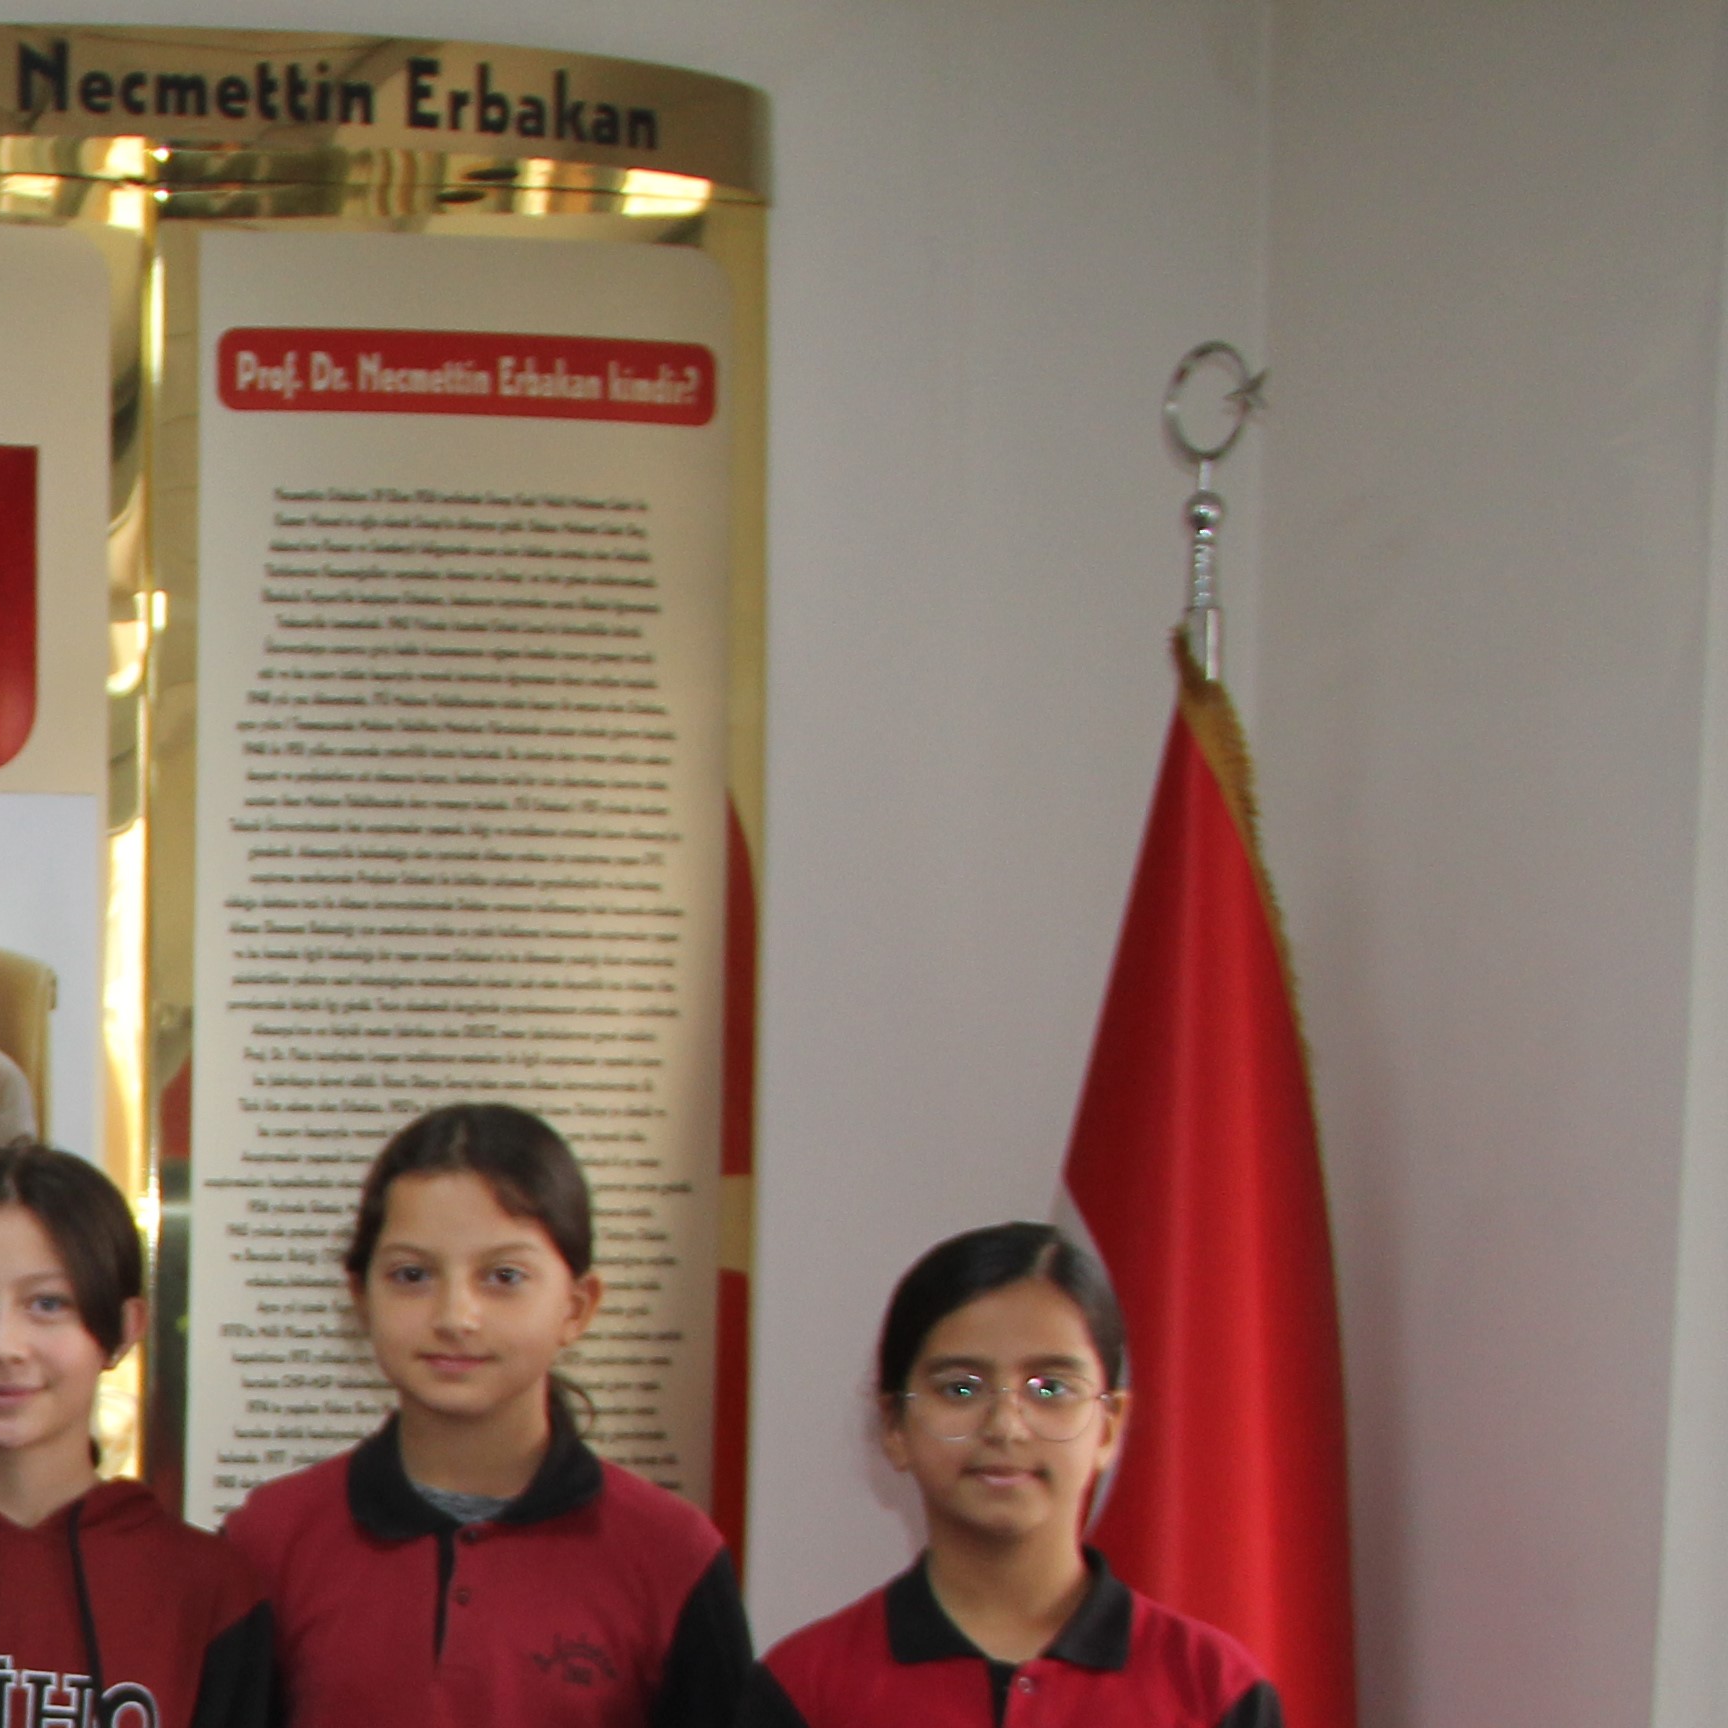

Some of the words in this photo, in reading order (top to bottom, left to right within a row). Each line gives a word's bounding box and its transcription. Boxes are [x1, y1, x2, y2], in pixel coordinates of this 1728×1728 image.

[17, 38, 374, 126] Necmettin
[406, 56, 661, 152] Erbakan
[235, 349, 302, 402] Prof.
[309, 352, 350, 393] Dr.
[358, 352, 491, 398] Necmettin
[498, 356, 600, 402] Erbakan
[608, 358, 701, 408] kimdir?
